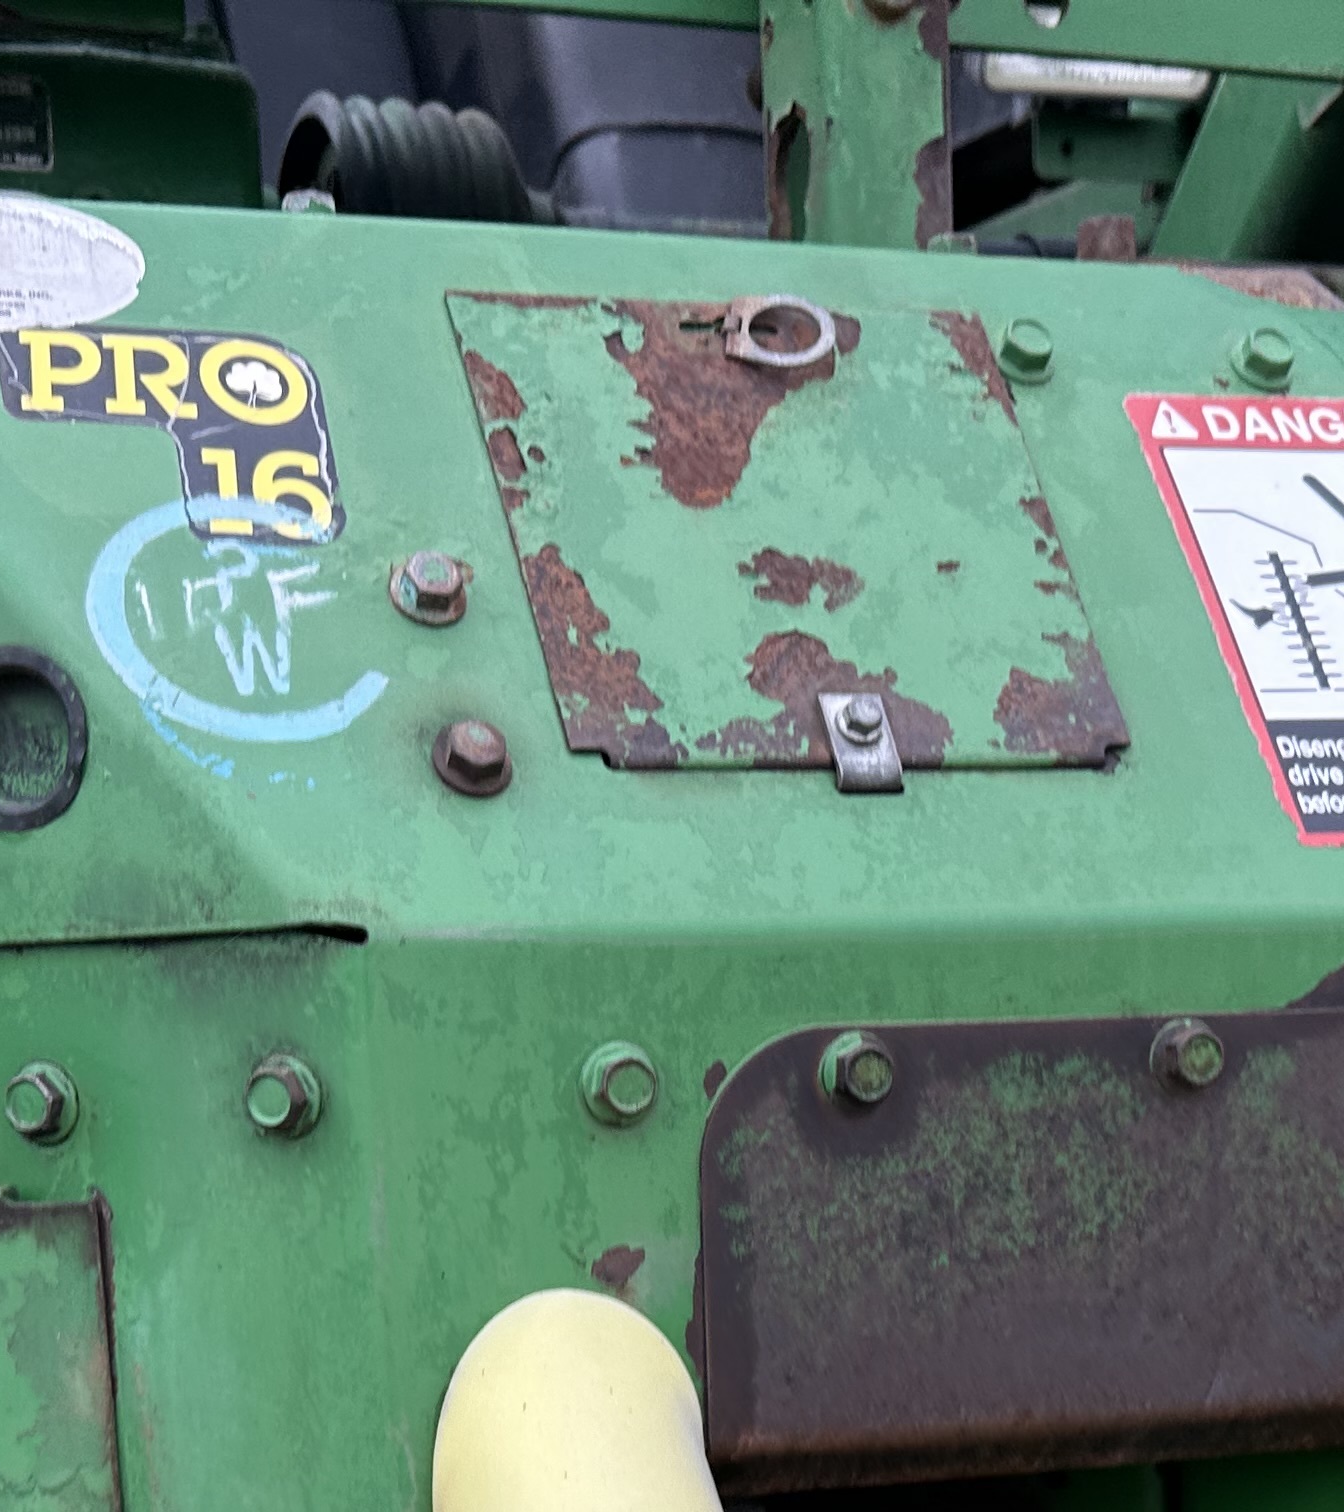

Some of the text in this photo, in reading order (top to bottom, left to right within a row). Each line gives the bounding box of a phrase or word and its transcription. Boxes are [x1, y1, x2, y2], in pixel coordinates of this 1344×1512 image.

[19, 330, 308, 426] PRO
[201, 447, 333, 540] 16
[1288, 762, 1344, 787] drive
